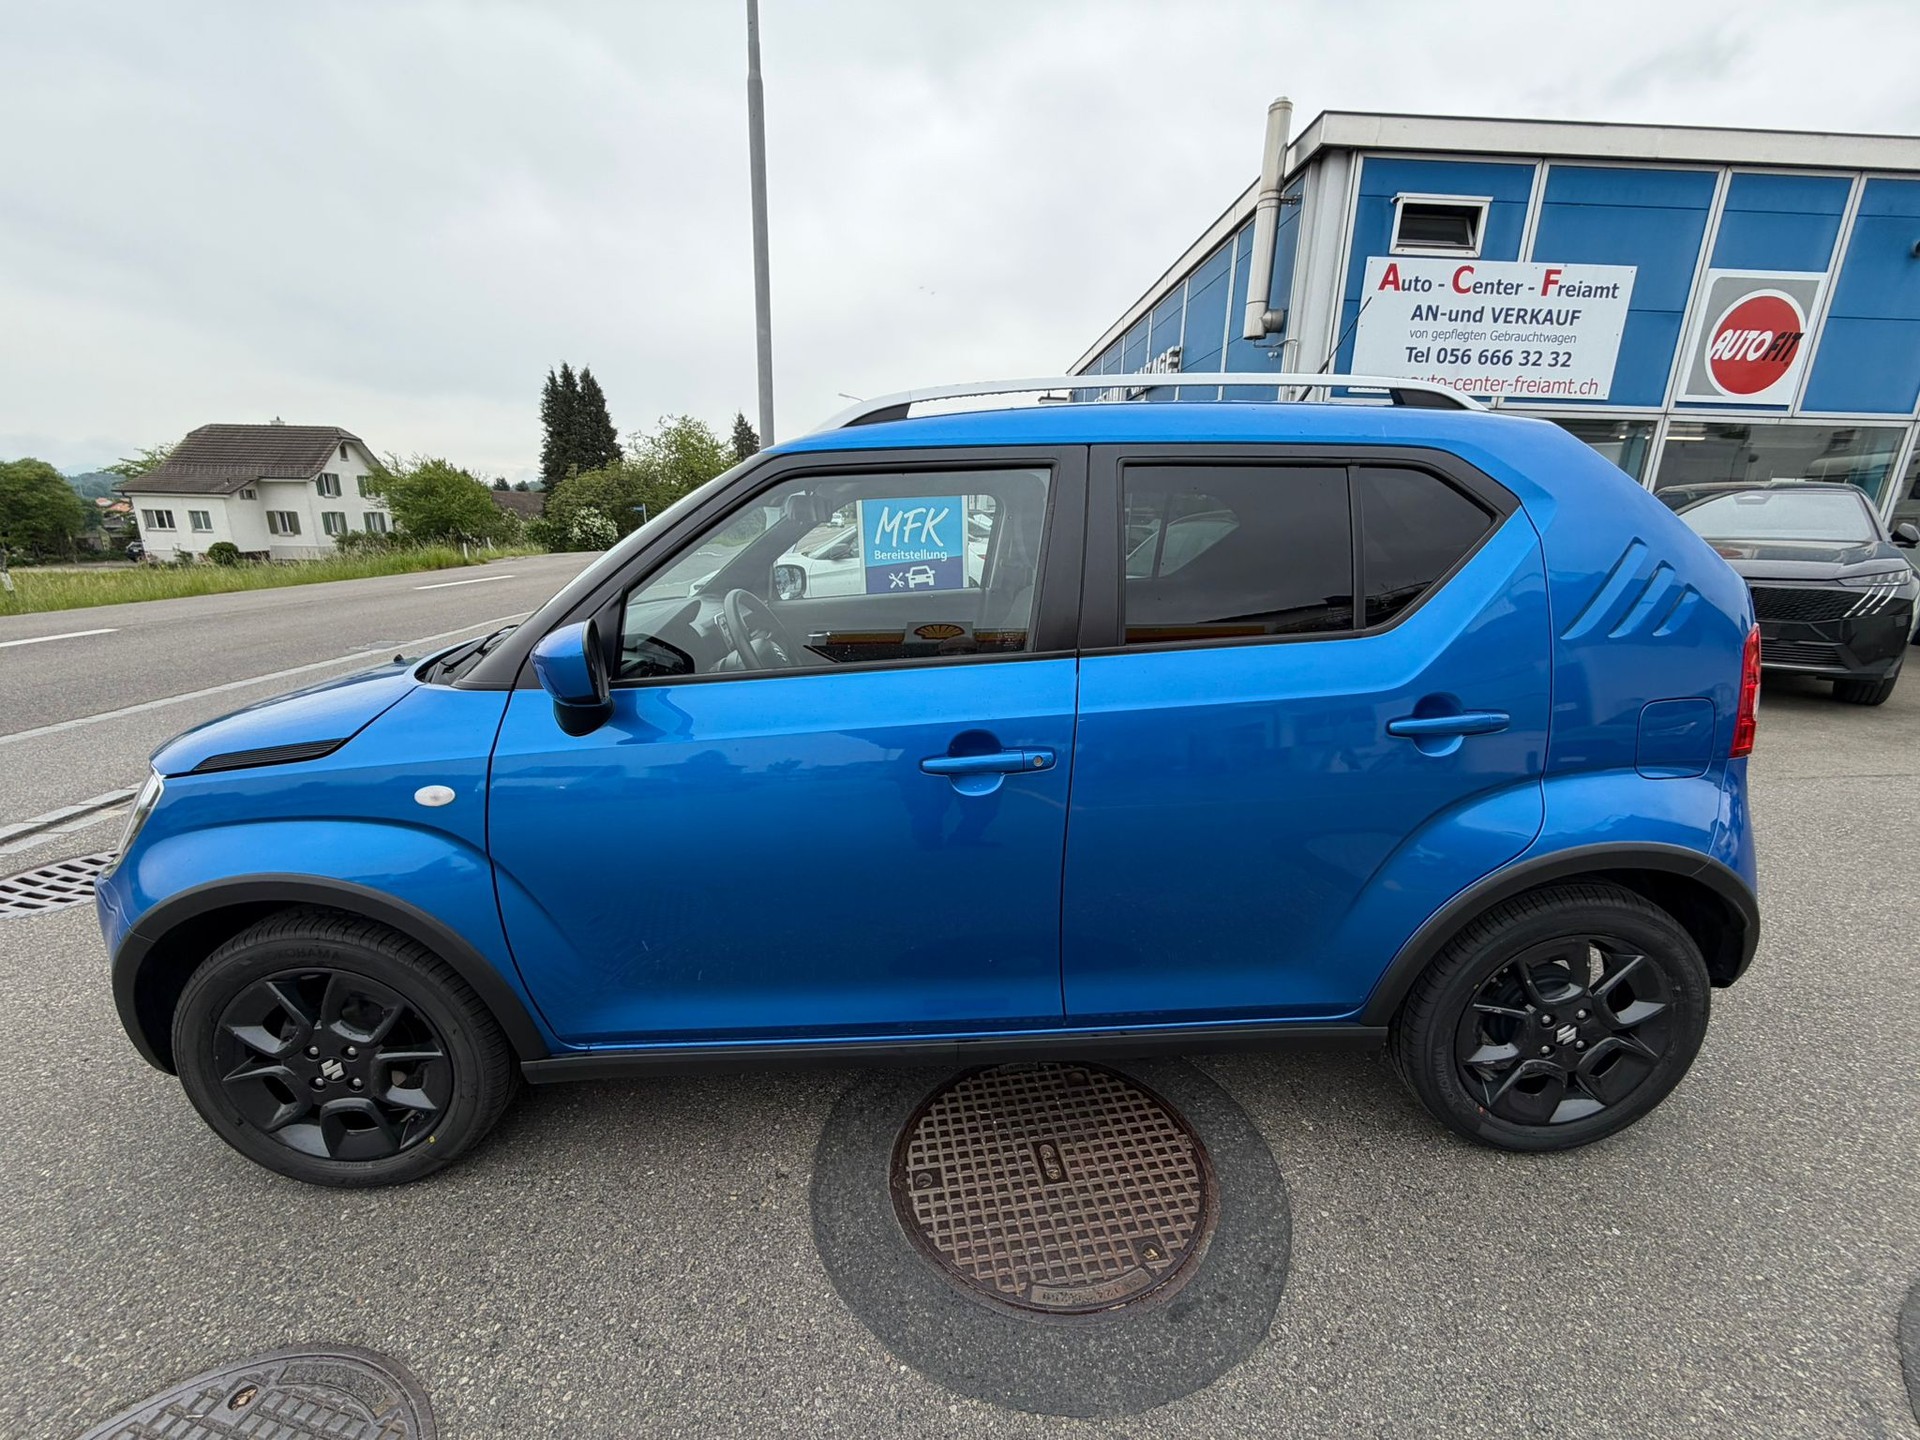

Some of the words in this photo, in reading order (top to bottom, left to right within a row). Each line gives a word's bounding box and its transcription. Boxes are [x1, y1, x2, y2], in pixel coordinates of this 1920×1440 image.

[1378, 262, 1433, 293] Auto
[1452, 265, 1523, 296] Center
[1541, 269, 1620, 300] Freiamt
[1410, 304, 1484, 324] AN-und
[1491, 307, 1582, 327] VERKAUF
[1409, 329, 1429, 339] von
[1431, 328, 1487, 343] gepflegten
[1490, 330, 1577, 345] Gebrauchtwagen
[1405, 347, 1430, 364] Tel
[1436, 347, 1471, 366] 056
[1478, 349, 1513, 367] 666
[1518, 350, 1543, 368] 32
[1547, 351, 1572, 368] 32
[875, 506, 950, 547] MFK
[874, 549, 948, 563] Bereitstellung
